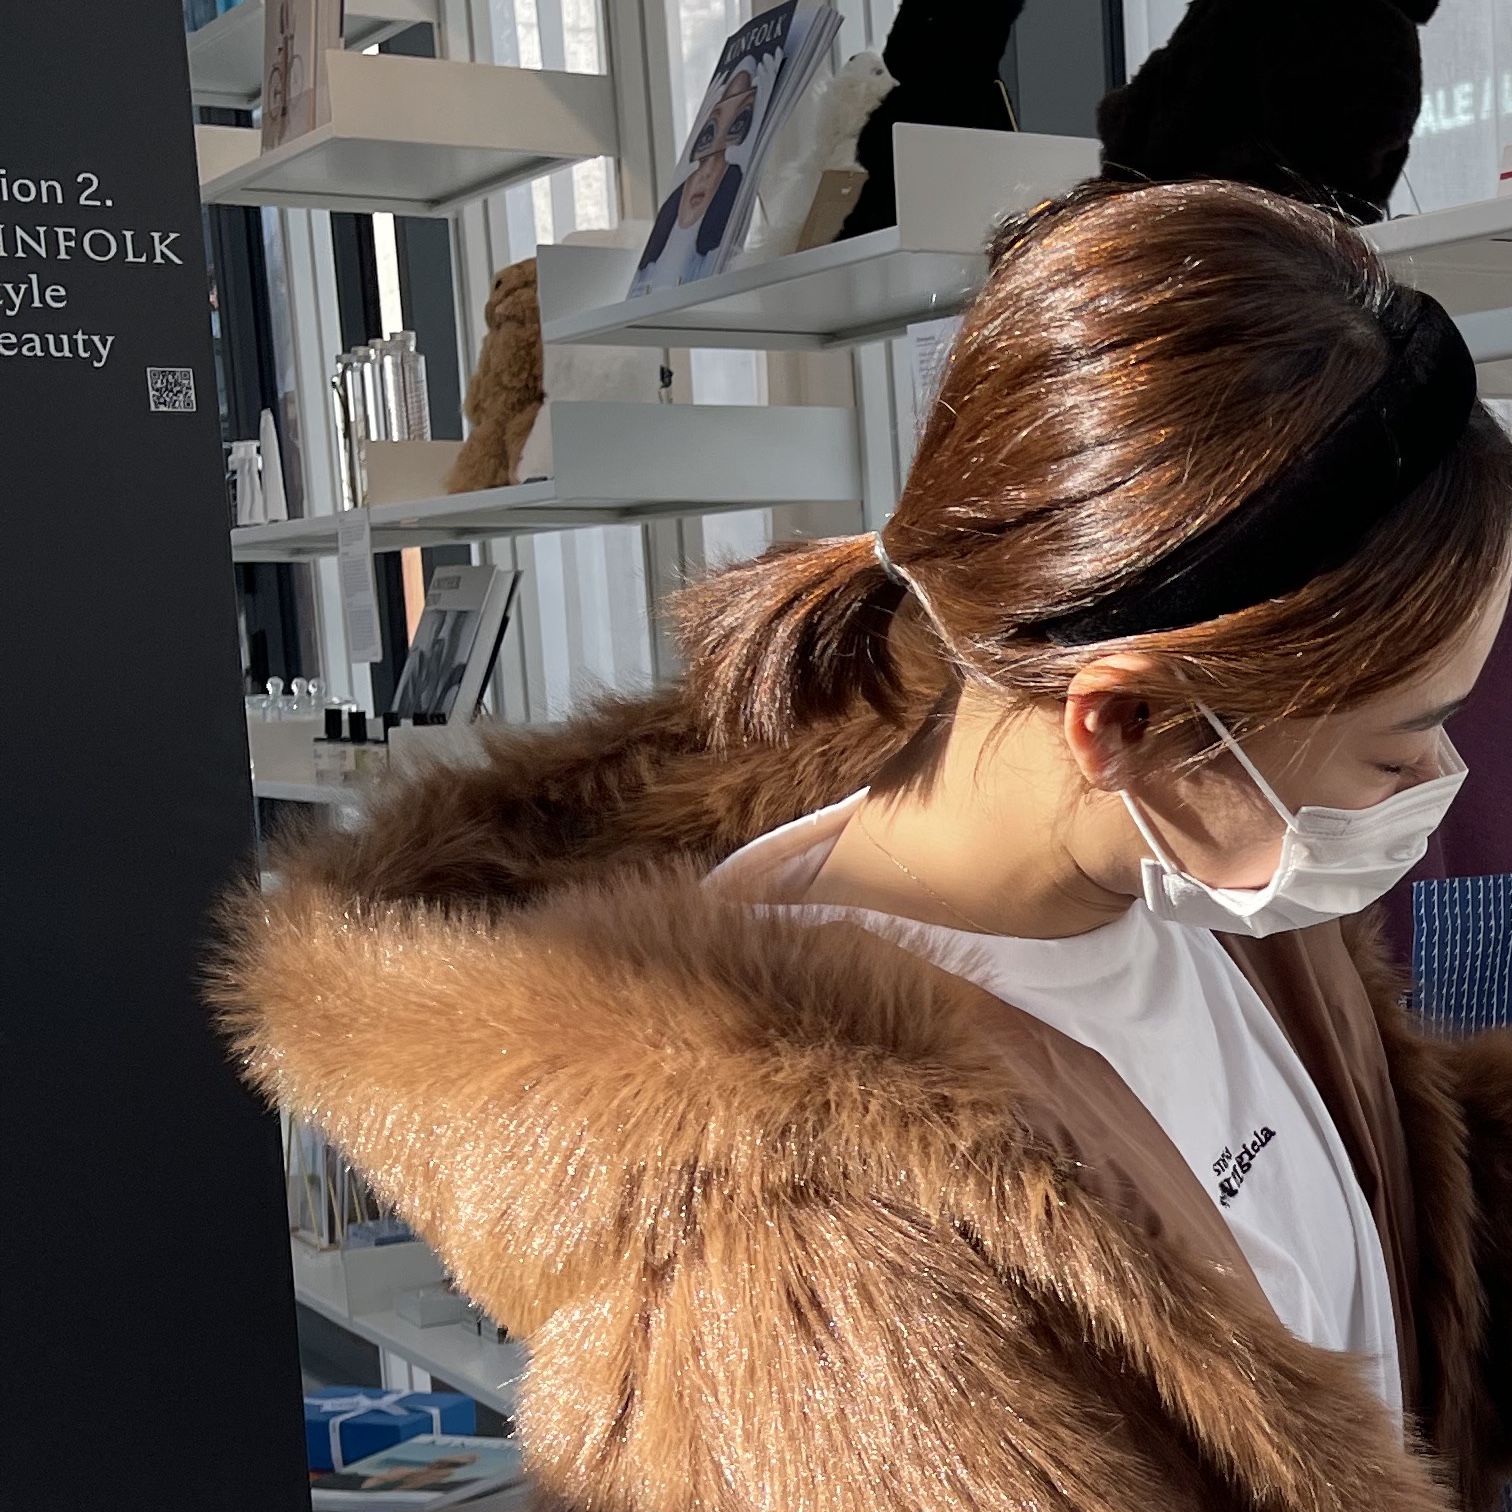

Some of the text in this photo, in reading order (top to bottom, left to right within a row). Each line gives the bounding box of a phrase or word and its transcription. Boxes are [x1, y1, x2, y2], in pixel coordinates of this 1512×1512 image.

[77, 173, 113, 207] 2.
[0, 273, 67, 316] yle
[0, 328, 115, 367] eauty
